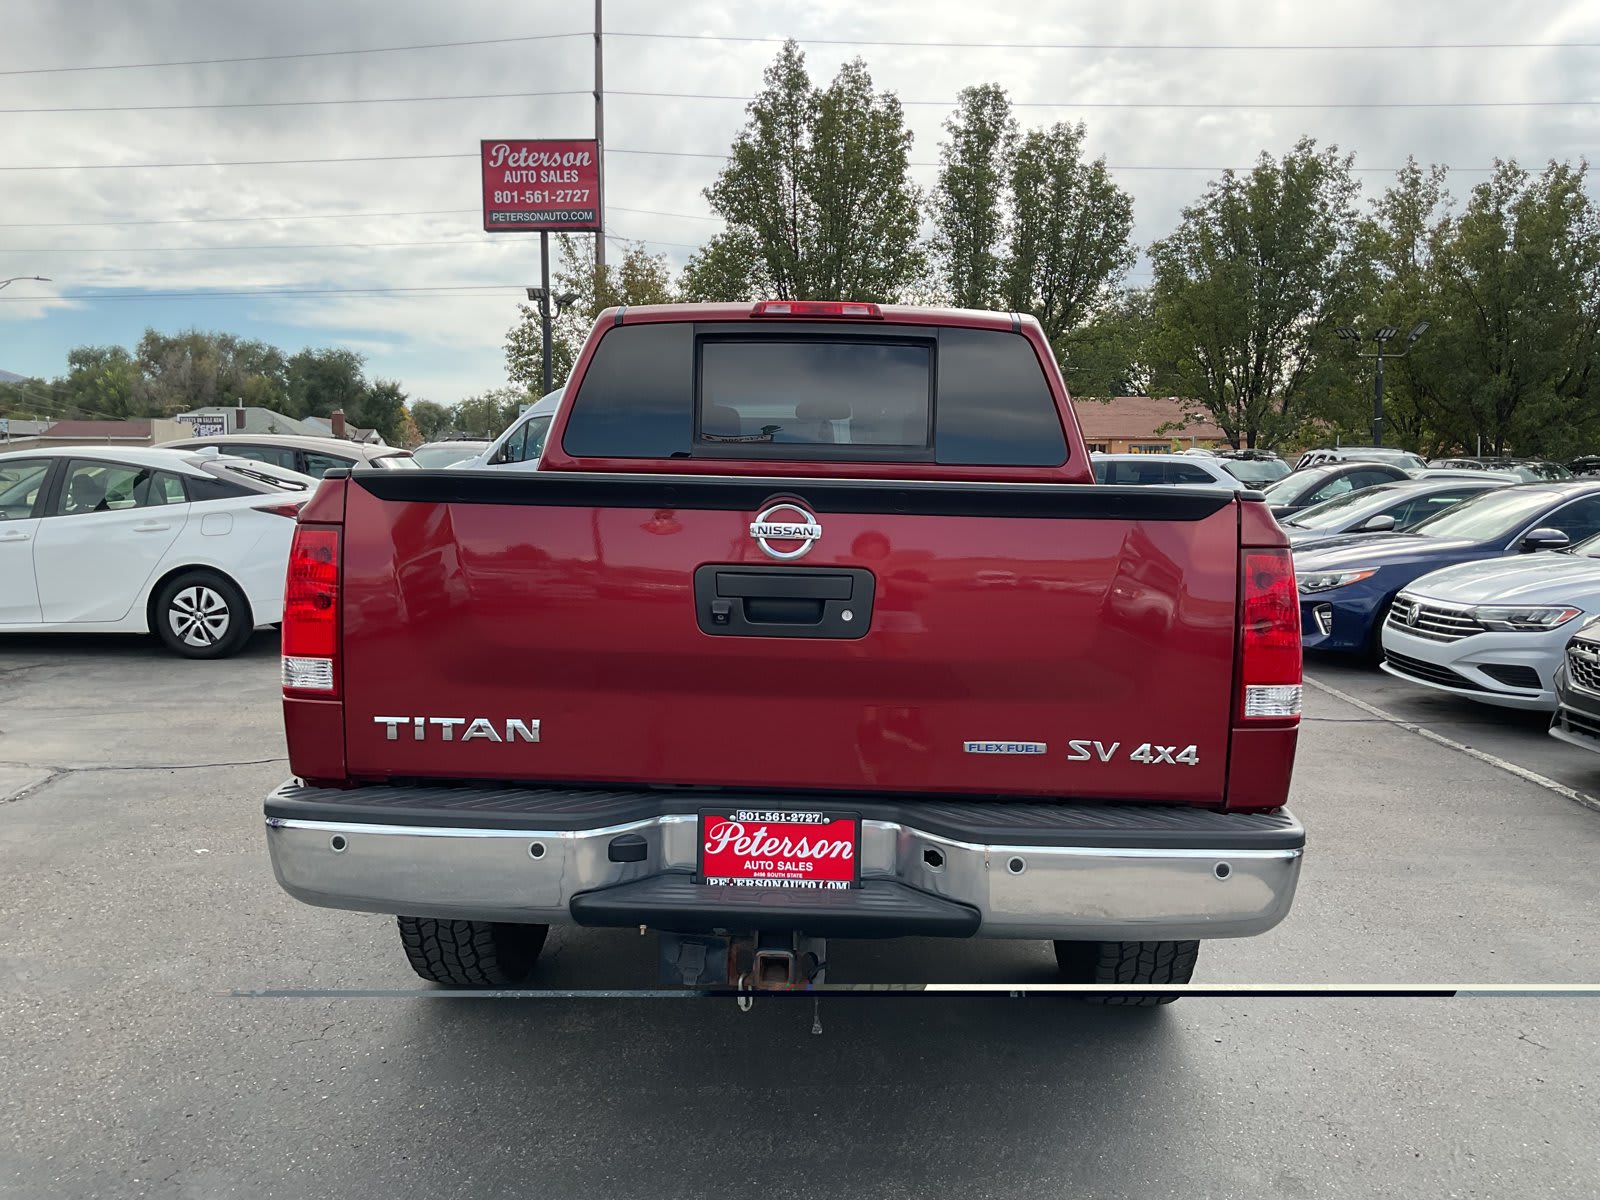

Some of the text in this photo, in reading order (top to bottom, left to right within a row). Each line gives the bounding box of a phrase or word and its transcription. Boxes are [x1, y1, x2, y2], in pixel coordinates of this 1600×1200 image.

[489, 144, 592, 167] Peterson
[504, 170, 579, 183] AUTO SALES
[494, 189, 590, 203] 801-561-2727
[492, 211, 592, 221] PETERSONAUTO.COM
[757, 526, 814, 536] NISSAN
[374, 716, 540, 742] TITAN
[968, 743, 1042, 753] FLEX FUEL
[1067, 739, 1120, 762] SV
[738, 811, 820, 823] 801-561-2727
[705, 821, 853, 859] Peterson
[744, 861, 813, 872] AUTO SALES
